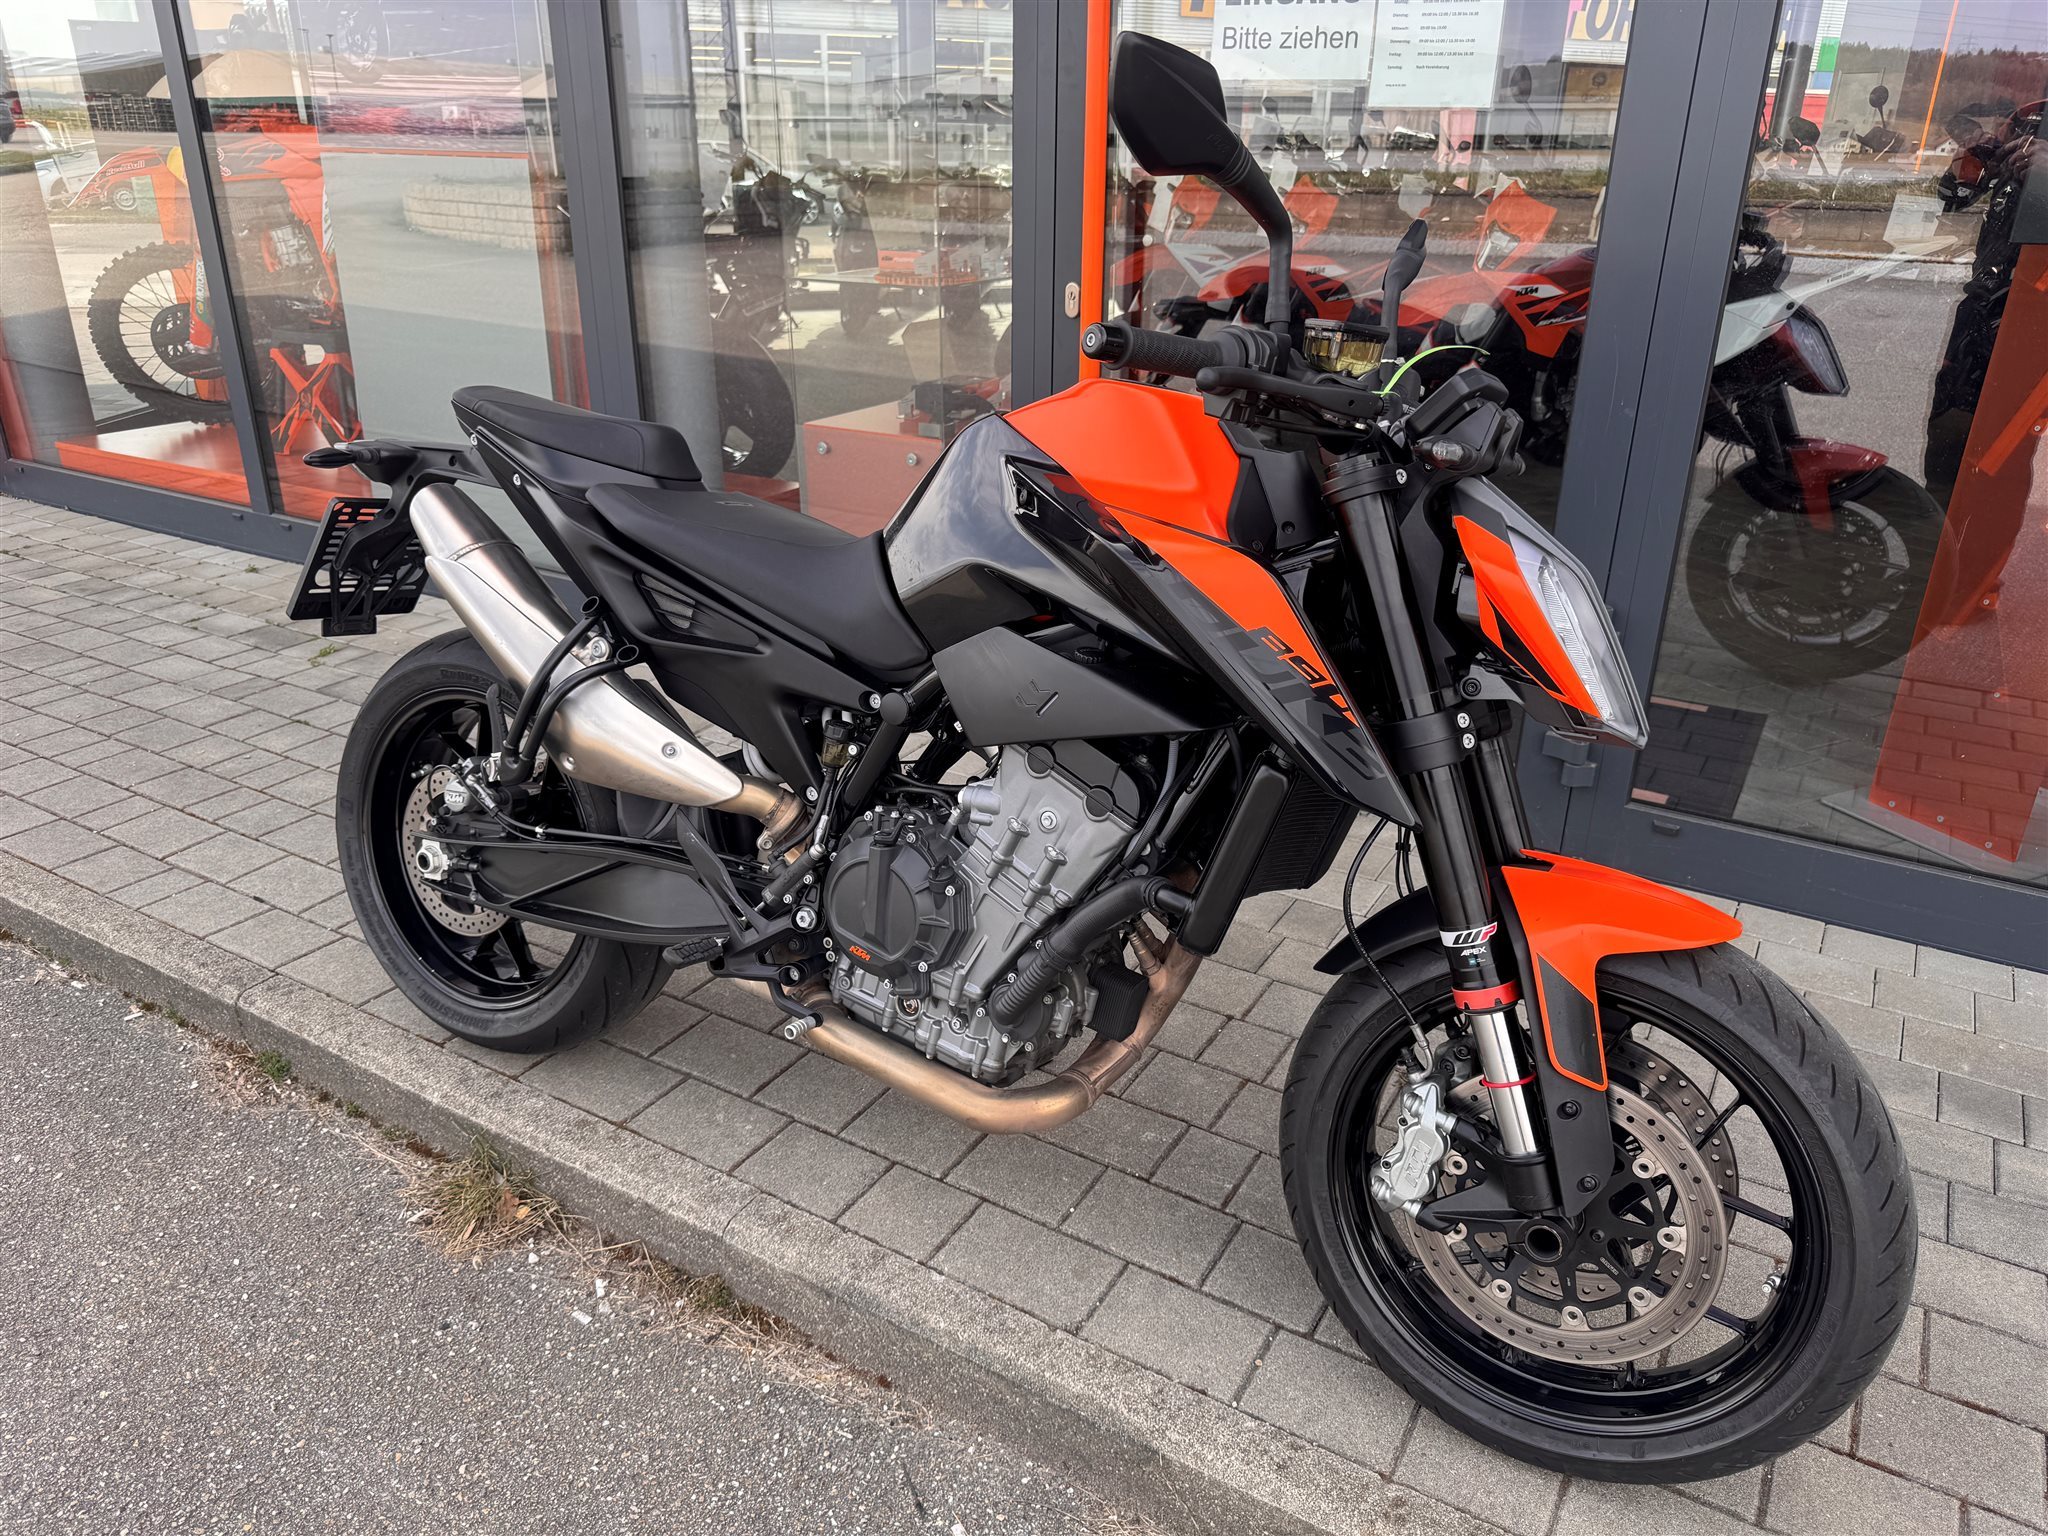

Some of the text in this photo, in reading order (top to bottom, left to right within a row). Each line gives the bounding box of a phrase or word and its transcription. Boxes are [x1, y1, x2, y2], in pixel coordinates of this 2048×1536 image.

[1221, 25, 1359, 49] Bitte ziehen
[1515, 285, 1540, 297] KTM
[446, 793, 465, 804] KTM
[1453, 924, 1497, 946] WP
[849, 945, 871, 961] KTM
[1460, 946, 1487, 957] APEX
[1405, 1140, 1432, 1188] KTM
